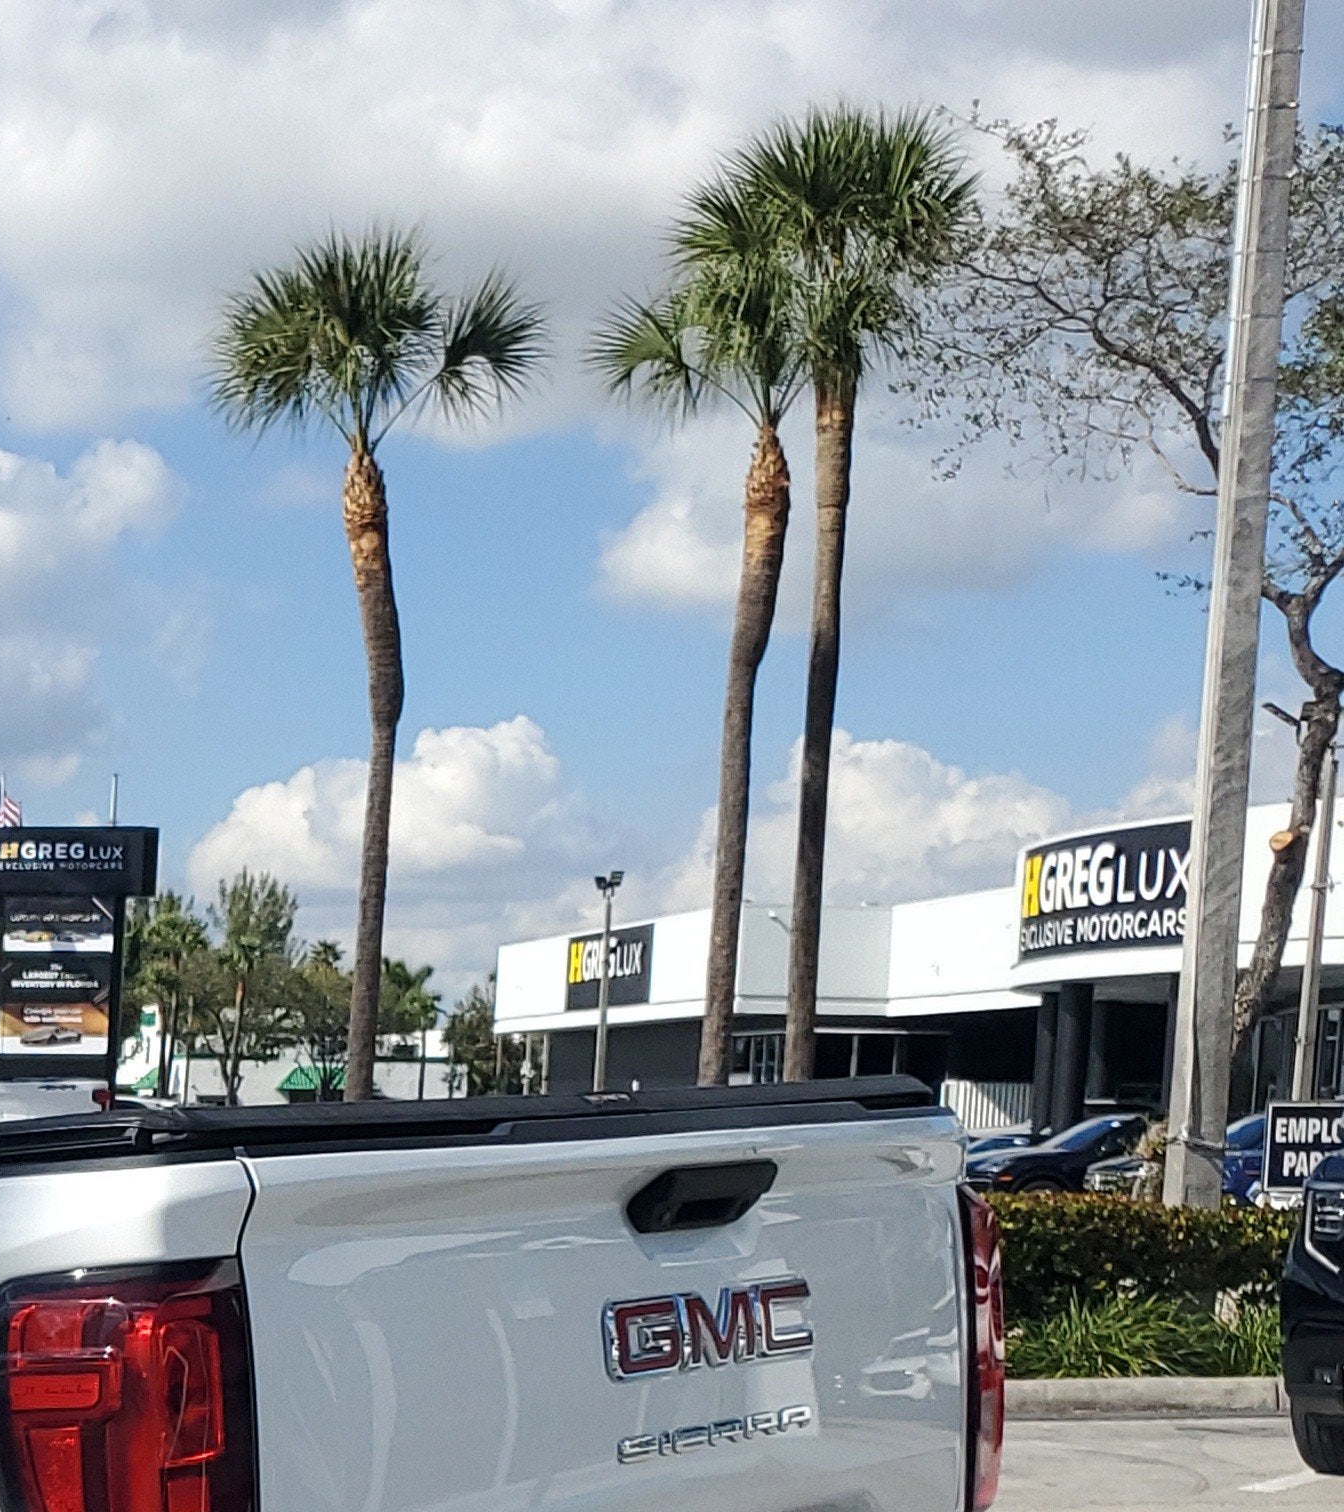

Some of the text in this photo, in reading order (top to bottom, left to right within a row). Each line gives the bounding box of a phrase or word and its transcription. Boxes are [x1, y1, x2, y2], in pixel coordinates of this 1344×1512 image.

[0, 841, 123, 860] HGREG LUX
[1022, 842, 1192, 919] HGREG LUX
[1075, 907, 1188, 943] MOTORCARS
[616, 940, 643, 977] LUX
[601, 1272, 814, 1382] GMC
[617, 1404, 812, 1464] SIERRA
